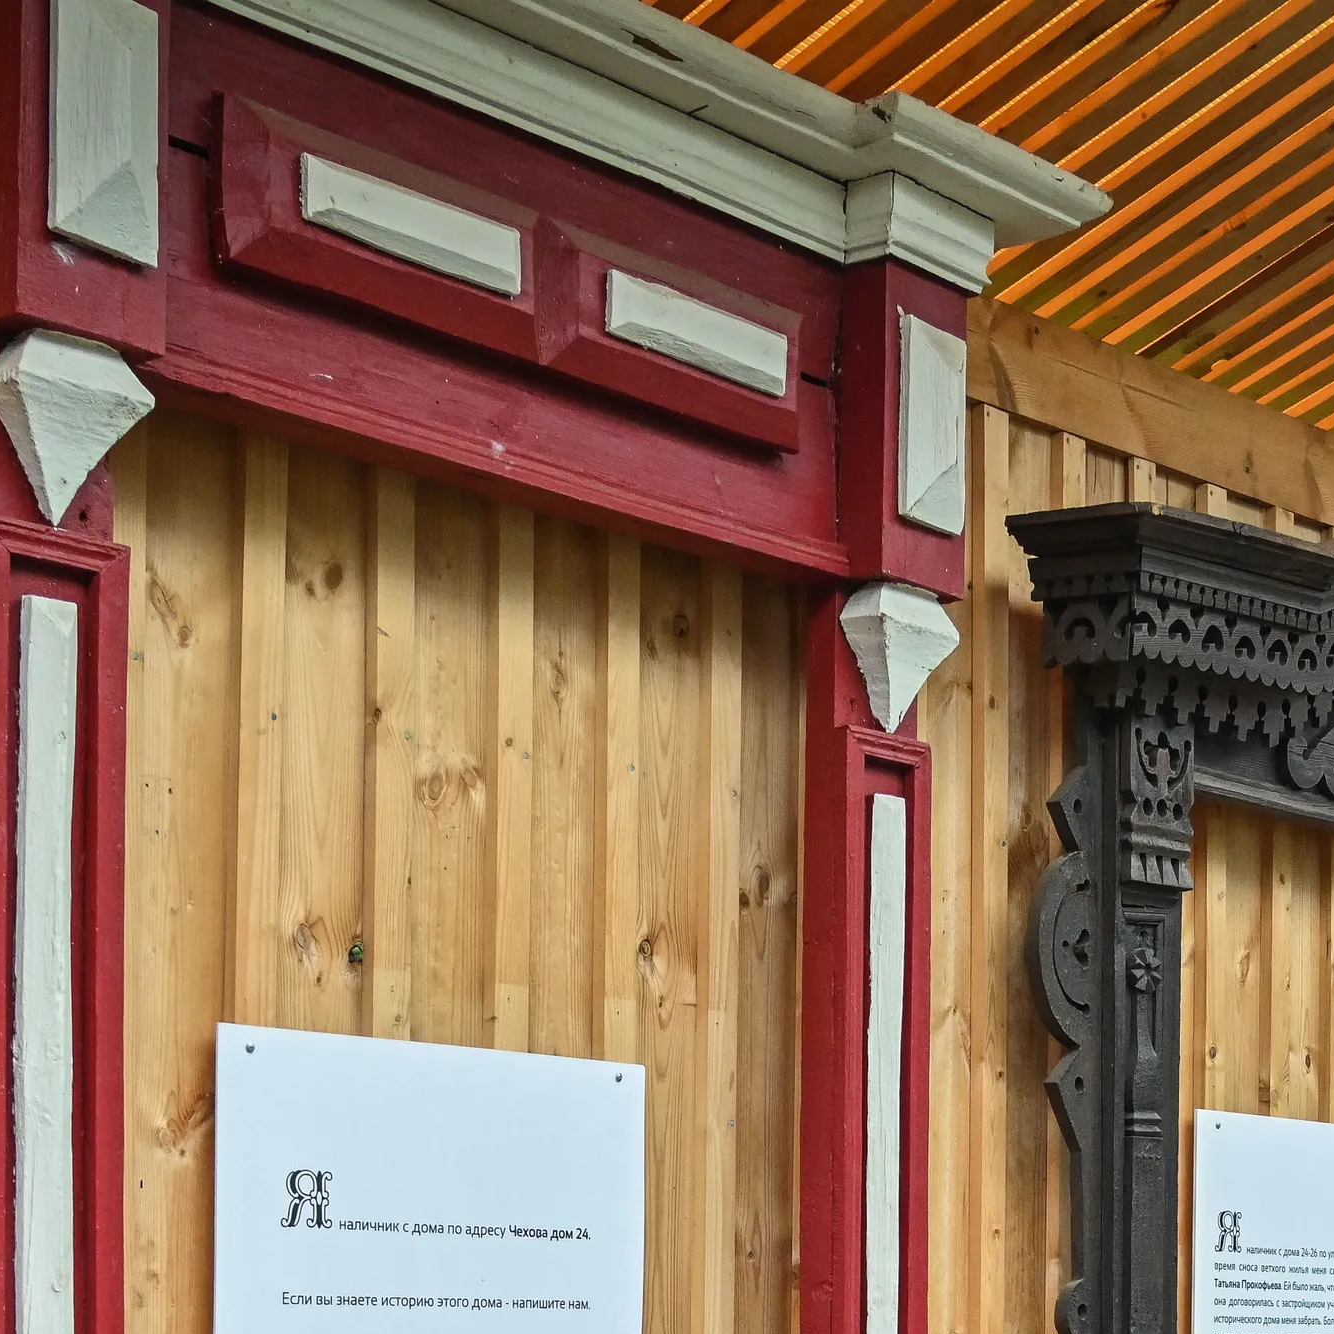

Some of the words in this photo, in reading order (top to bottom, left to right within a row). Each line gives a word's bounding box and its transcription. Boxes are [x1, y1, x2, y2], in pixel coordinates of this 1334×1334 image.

[281, 1169, 333, 1228] Я
[339, 1220, 399, 1232] наличник
[403, 1223, 409, 1233] с
[412, 1224, 444, 1236] дома
[448, 1224, 462, 1234] по
[466, 1225, 505, 1239] адресу
[509, 1225, 548, 1238] Чехова
[550, 1229, 573, 1241] дом
[576, 1228, 591, 1240] 24.
[1215, 1210, 1242, 1252] Я
[1247, 1246, 1277, 1255] наличник
[1283, 1249, 1299, 1257] дома
[1301, 1248, 1317, 1257] 24-26
[1215, 1262, 1235, 1272] время
[1239, 1264, 1257, 1272] сноса
[1261, 1265, 1285, 1273] ветхого
[1289, 1266, 1309, 1274] жилья
[1214, 1278, 1240, 1288] Татьяна
[1284, 1281, 1291, 1290] Ей
[1293, 1281, 1308, 1291] было
[1309, 1284, 1326, 1292] жаль,
[282, 1292, 312, 1305] Если
[316, 1296, 332, 1305] вы
[337, 1296, 377, 1306] знаете
[382, 1296, 434, 1309] историю
[438, 1298, 469, 1308] этого
[472, 1298, 502, 1310] дома
[513, 1299, 565, 1309] напишите
[568, 1300, 590, 1310] нам.
[1228, 1298, 1274, 1308] договорилась
[1281, 1299, 1325, 1310] застройщиком
[1214, 1316, 1262, 1325] исторического
[1263, 1316, 1280, 1325] дома
